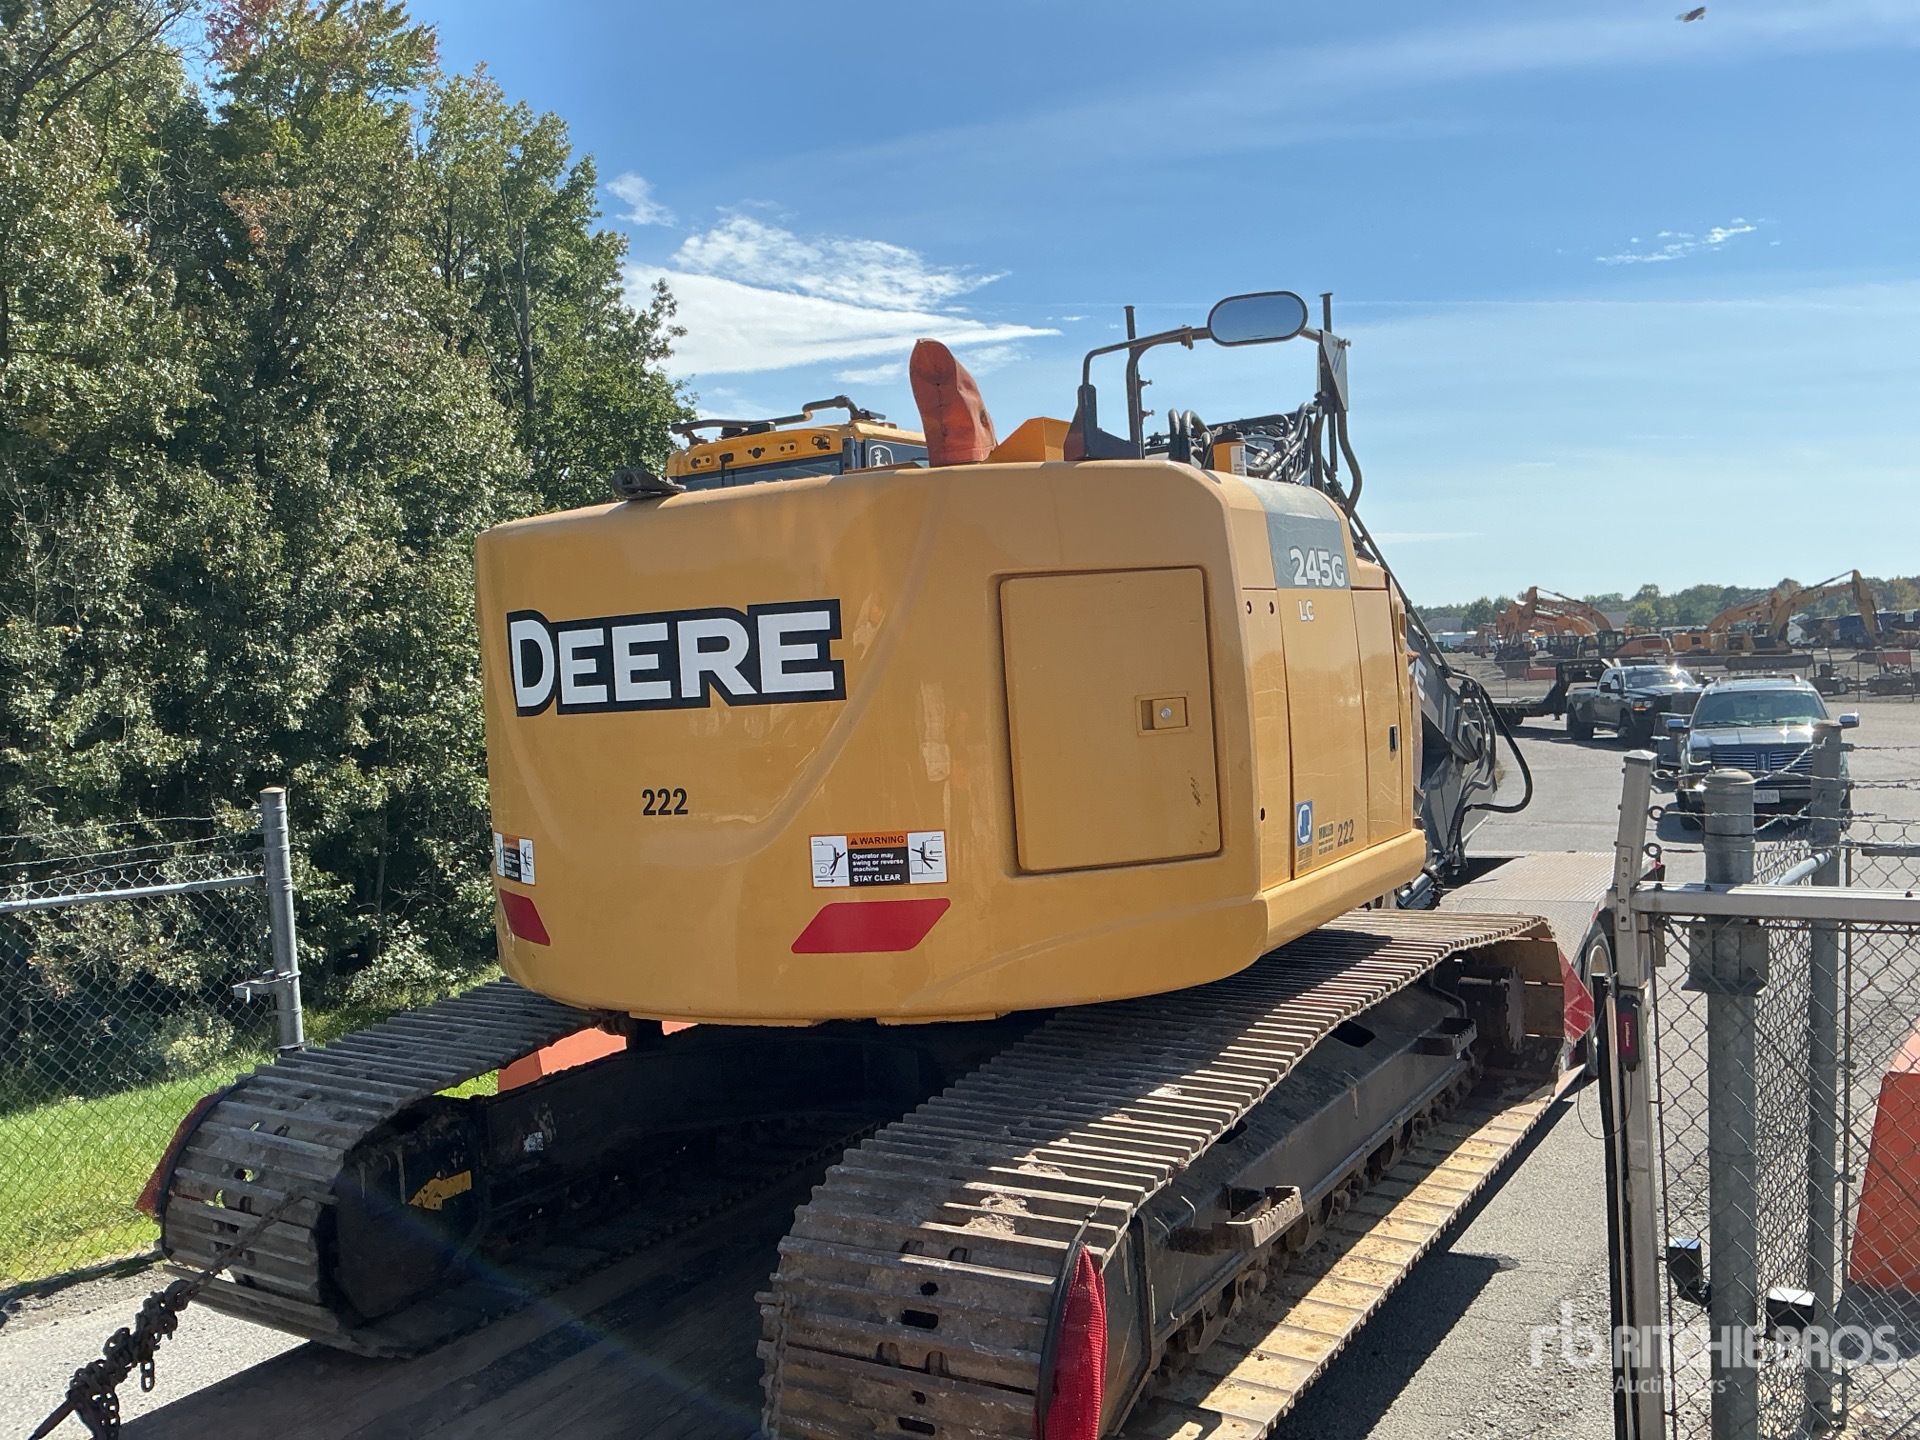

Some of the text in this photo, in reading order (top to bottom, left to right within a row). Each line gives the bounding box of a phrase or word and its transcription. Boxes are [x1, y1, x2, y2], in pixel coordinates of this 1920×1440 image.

[1289, 547, 1346, 588] 245G
[1298, 599, 1315, 621] LC
[509, 610, 836, 708] DEERE
[641, 787, 689, 816] 222
[859, 835, 905, 845] WARNING
[1337, 818, 1354, 847] 222
[874, 873, 901, 881] CLEAR
